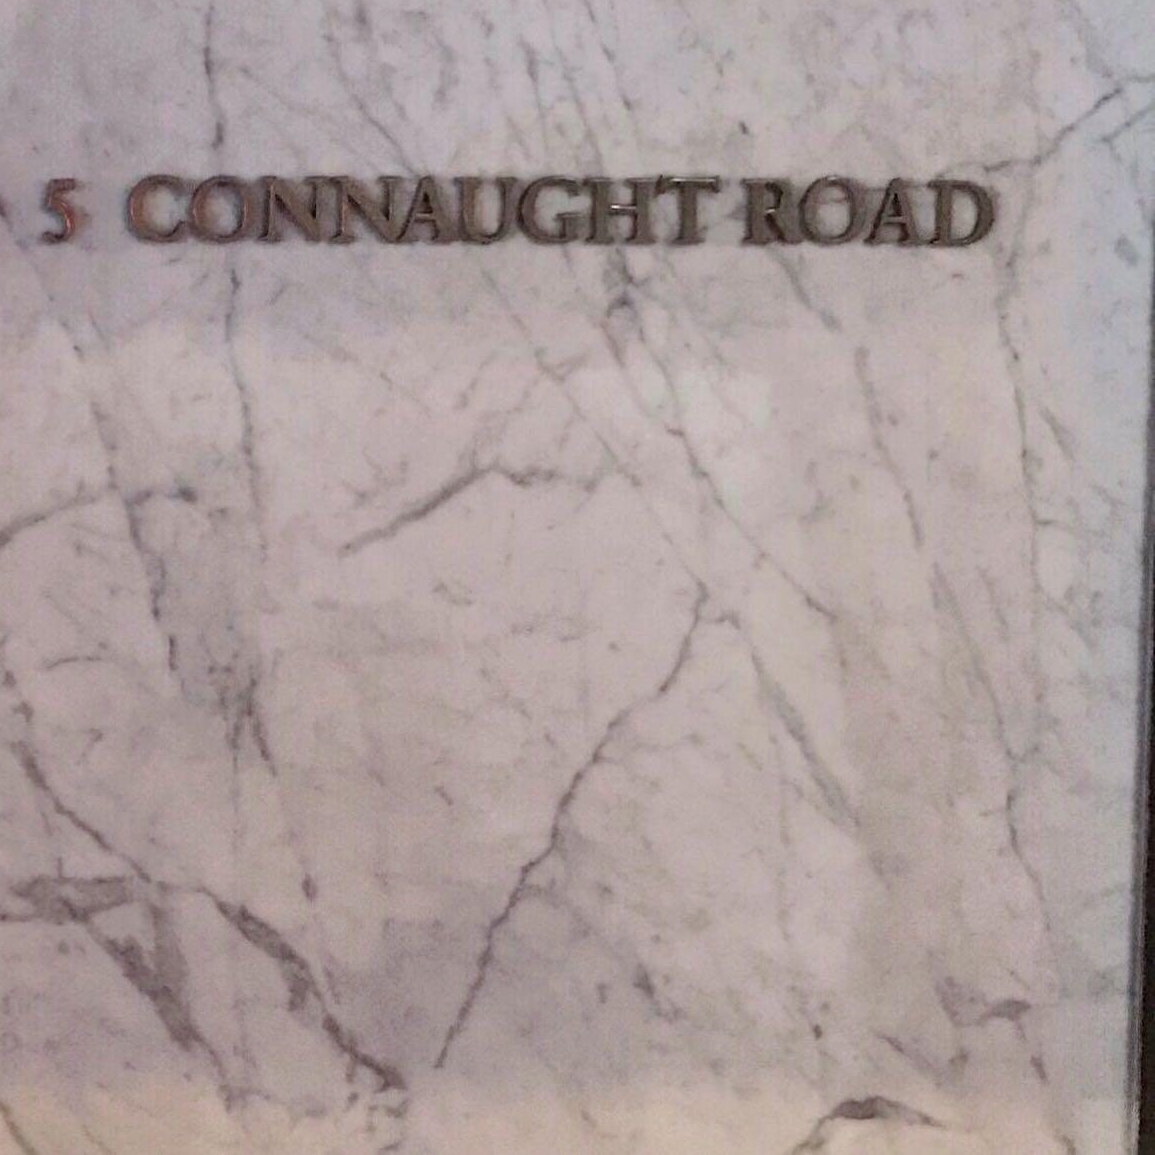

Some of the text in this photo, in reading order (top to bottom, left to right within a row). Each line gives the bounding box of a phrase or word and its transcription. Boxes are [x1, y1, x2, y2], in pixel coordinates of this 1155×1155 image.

[41, 174, 996, 246] 5 CONNAUGHT ROAD
